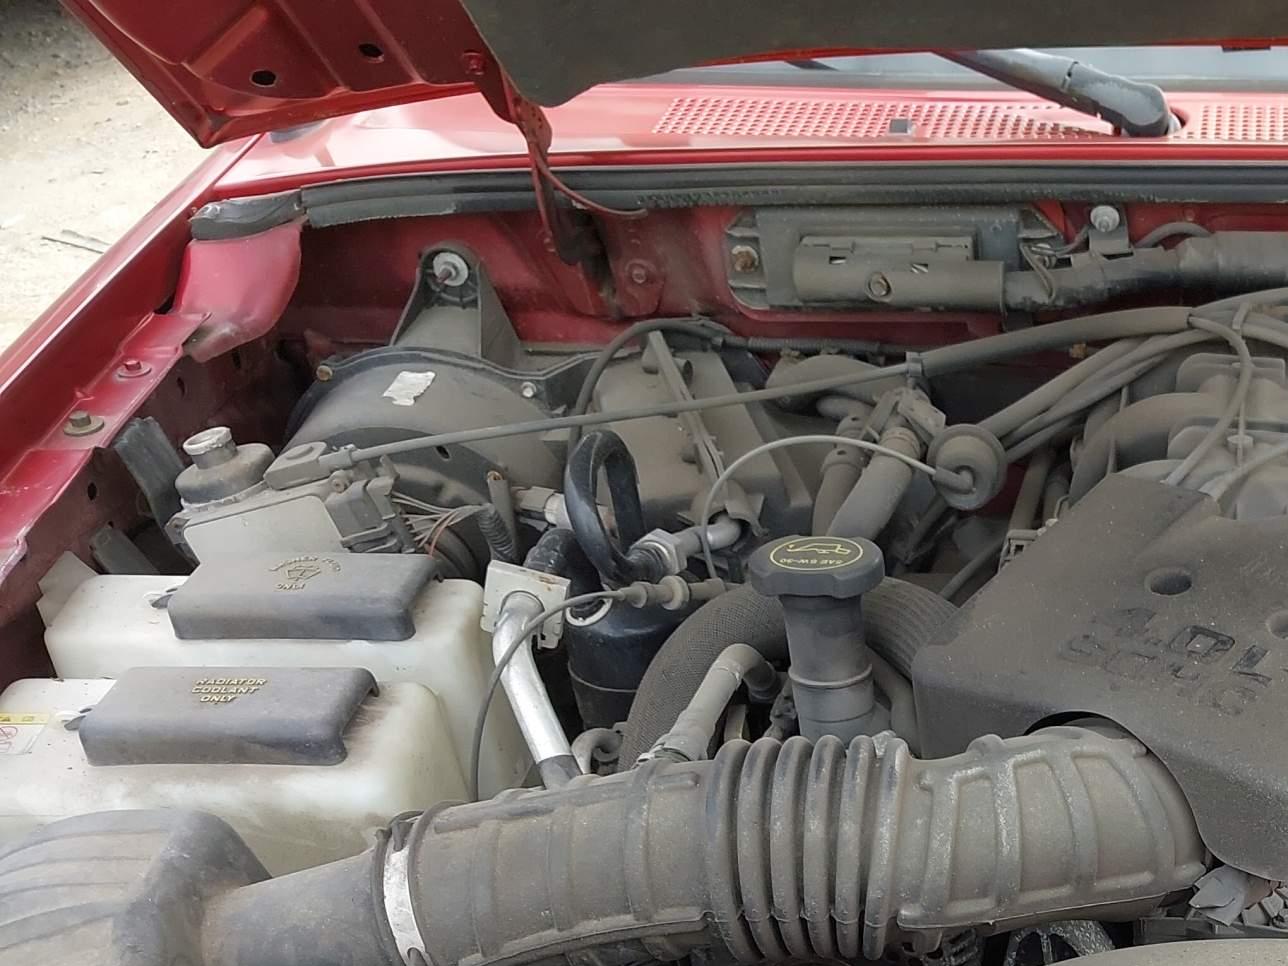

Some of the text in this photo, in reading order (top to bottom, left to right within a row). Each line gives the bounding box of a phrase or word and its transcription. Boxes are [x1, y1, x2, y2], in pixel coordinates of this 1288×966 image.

[196, 678, 267, 686] RADIATOR
[191, 686, 259, 694] COOLANT
[199, 694, 237, 703] ONLY
